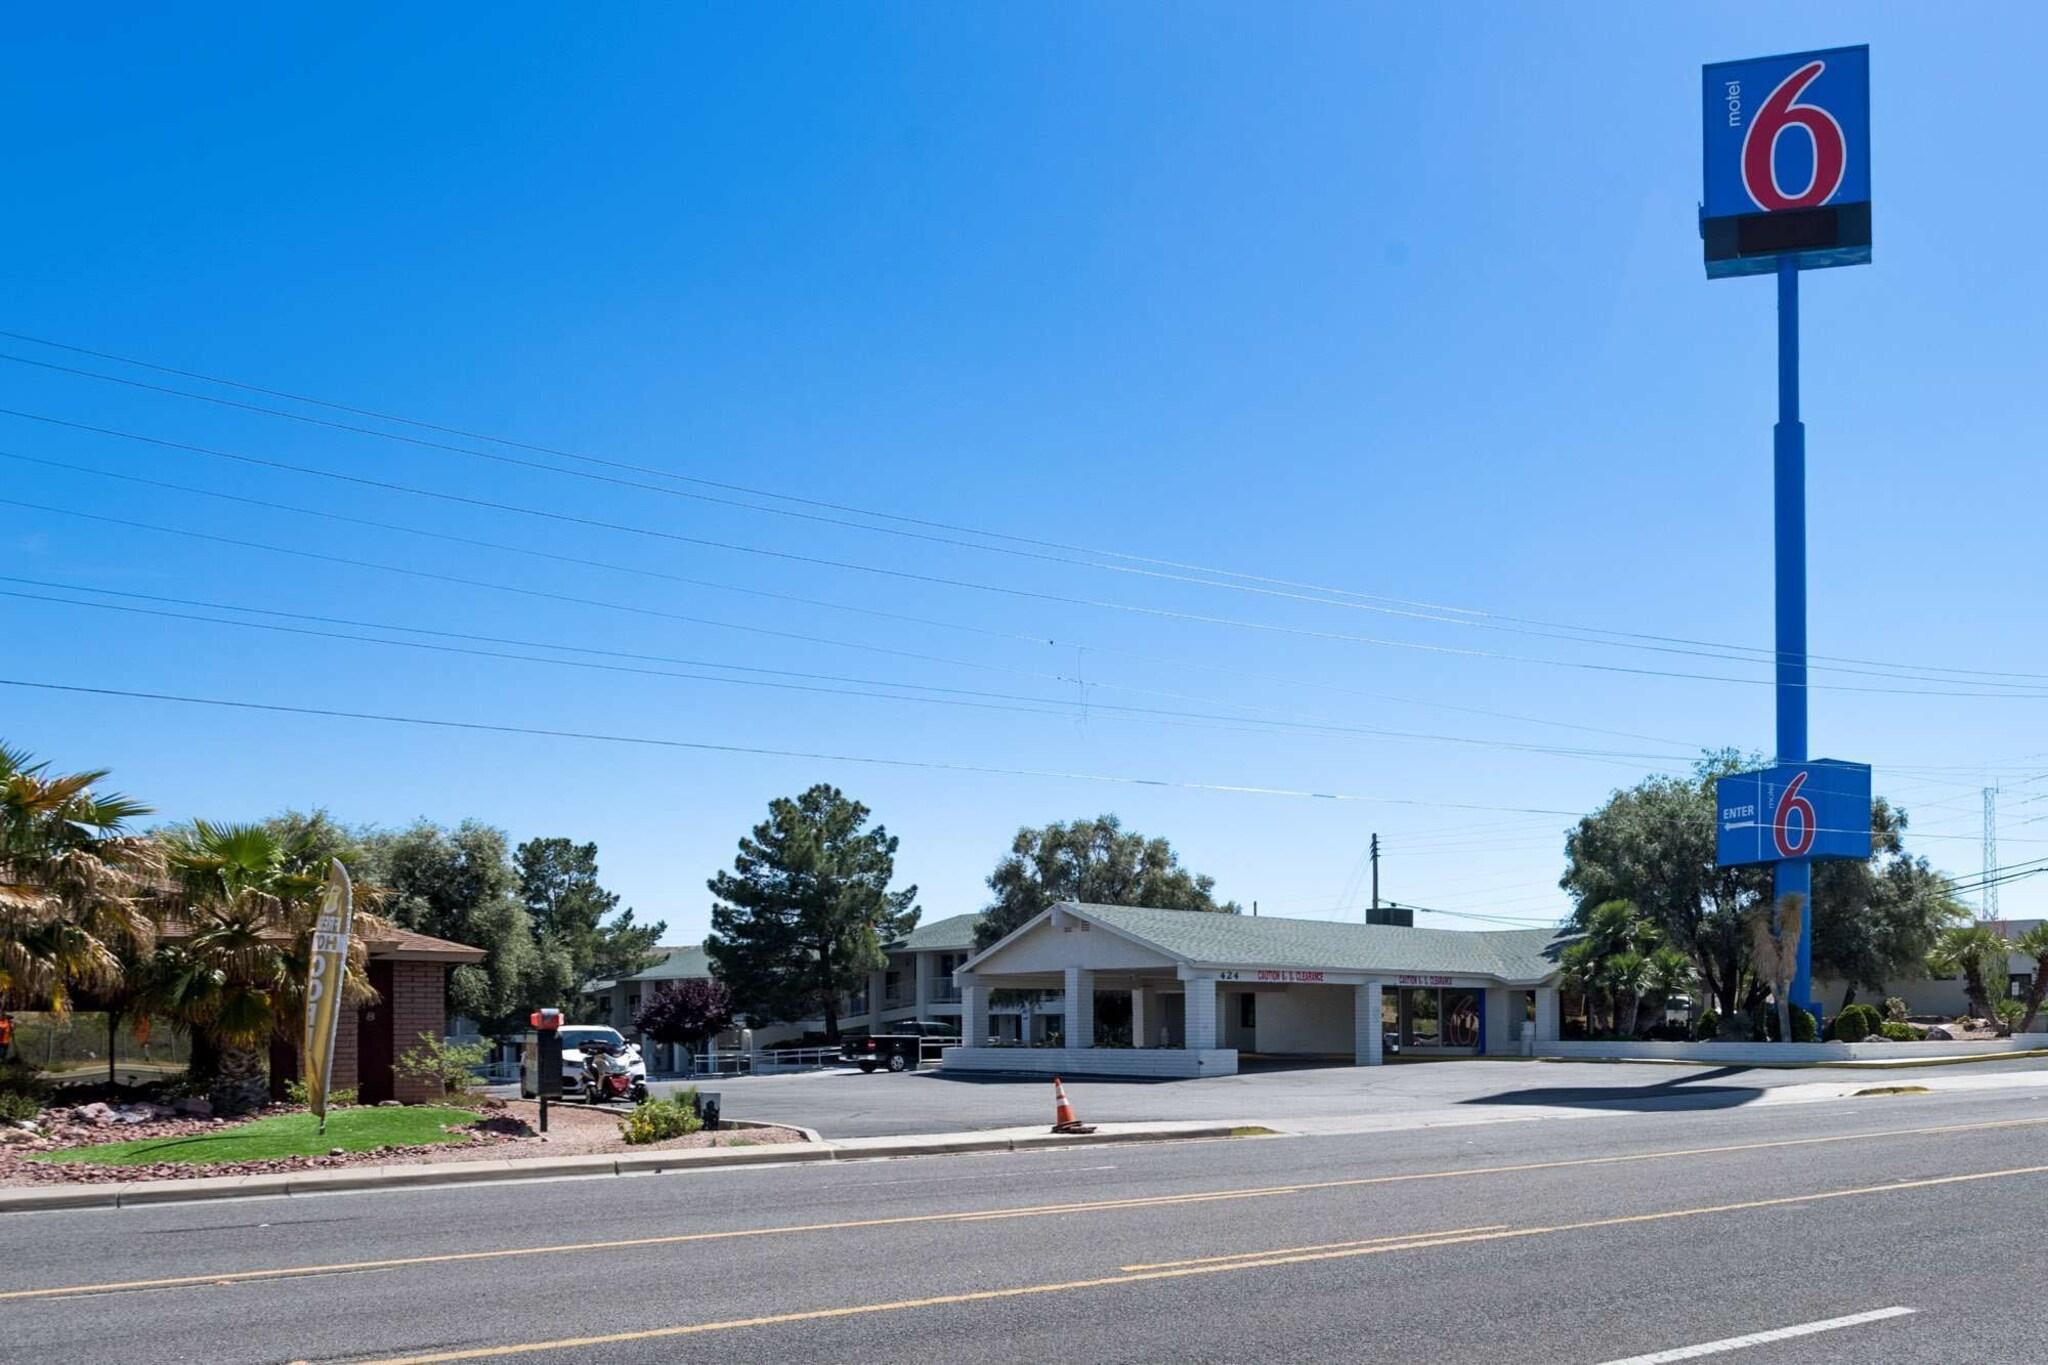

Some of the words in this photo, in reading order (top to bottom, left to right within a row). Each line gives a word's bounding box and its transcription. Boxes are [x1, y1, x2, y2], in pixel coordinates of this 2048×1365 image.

[1725, 80, 1741, 127] motel
[1740, 60, 1847, 212] 6
[1723, 805, 1754, 820] ENTER
[1773, 771, 1816, 857] 6
[1220, 970, 1239, 980] 424
